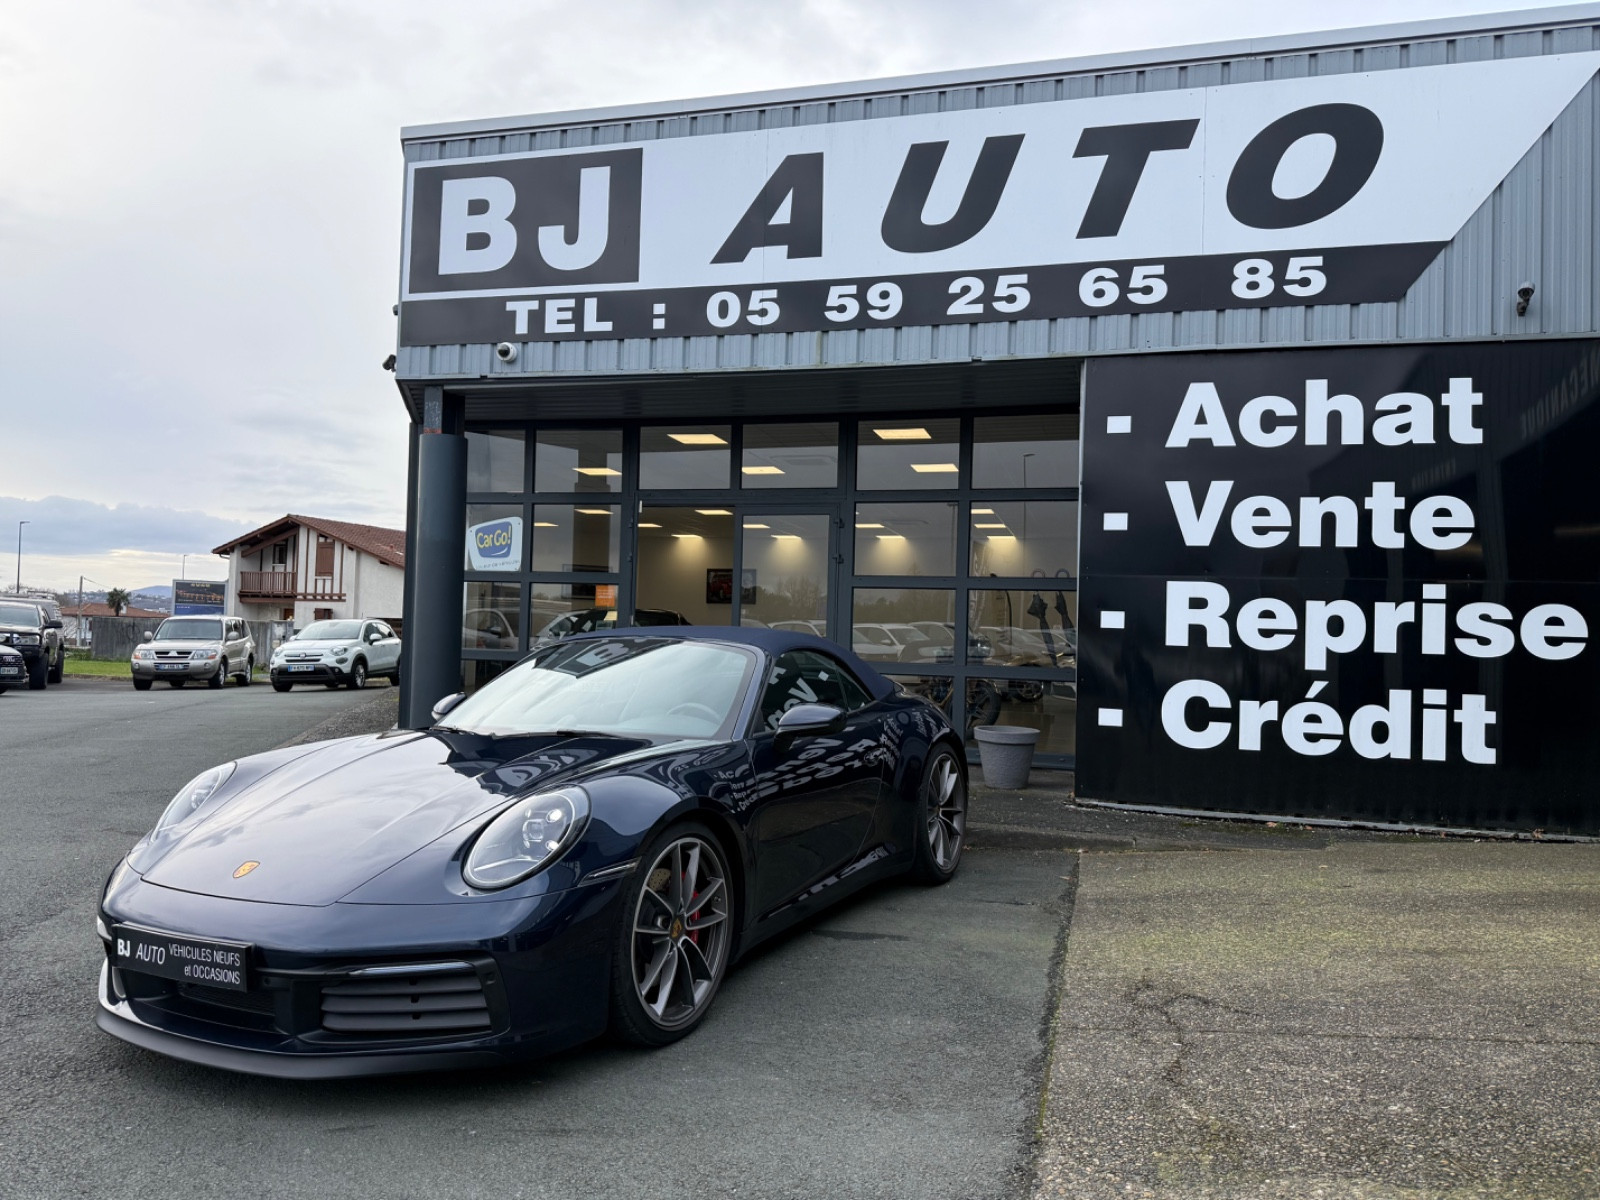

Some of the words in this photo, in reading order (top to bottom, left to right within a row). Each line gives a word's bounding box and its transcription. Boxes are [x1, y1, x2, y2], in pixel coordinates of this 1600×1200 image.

[438, 165, 611, 275] BJ
[709, 102, 1384, 264] AUTO
[506, 297, 613, 334] TEL
[706, 289, 781, 328] 05
[824, 281, 903, 322] 59
[946, 273, 1031, 315] 25
[1078, 264, 1168, 307] 65
[1231, 255, 1327, 299] 85
[1165, 377, 1483, 448] Achat
[1165, 480, 1475, 550] Vente
[1165, 580, 1589, 671] Reprise
[1161, 679, 1497, 765] Crédit
[118, 939, 131, 957] BJ
[136, 944, 165, 965] AUTO
[169, 943, 212, 962] VEHICULES
[214, 950, 240, 966] NEUFS
[184, 966, 192, 976] et
[193, 966, 240, 984] OCCASIONS
